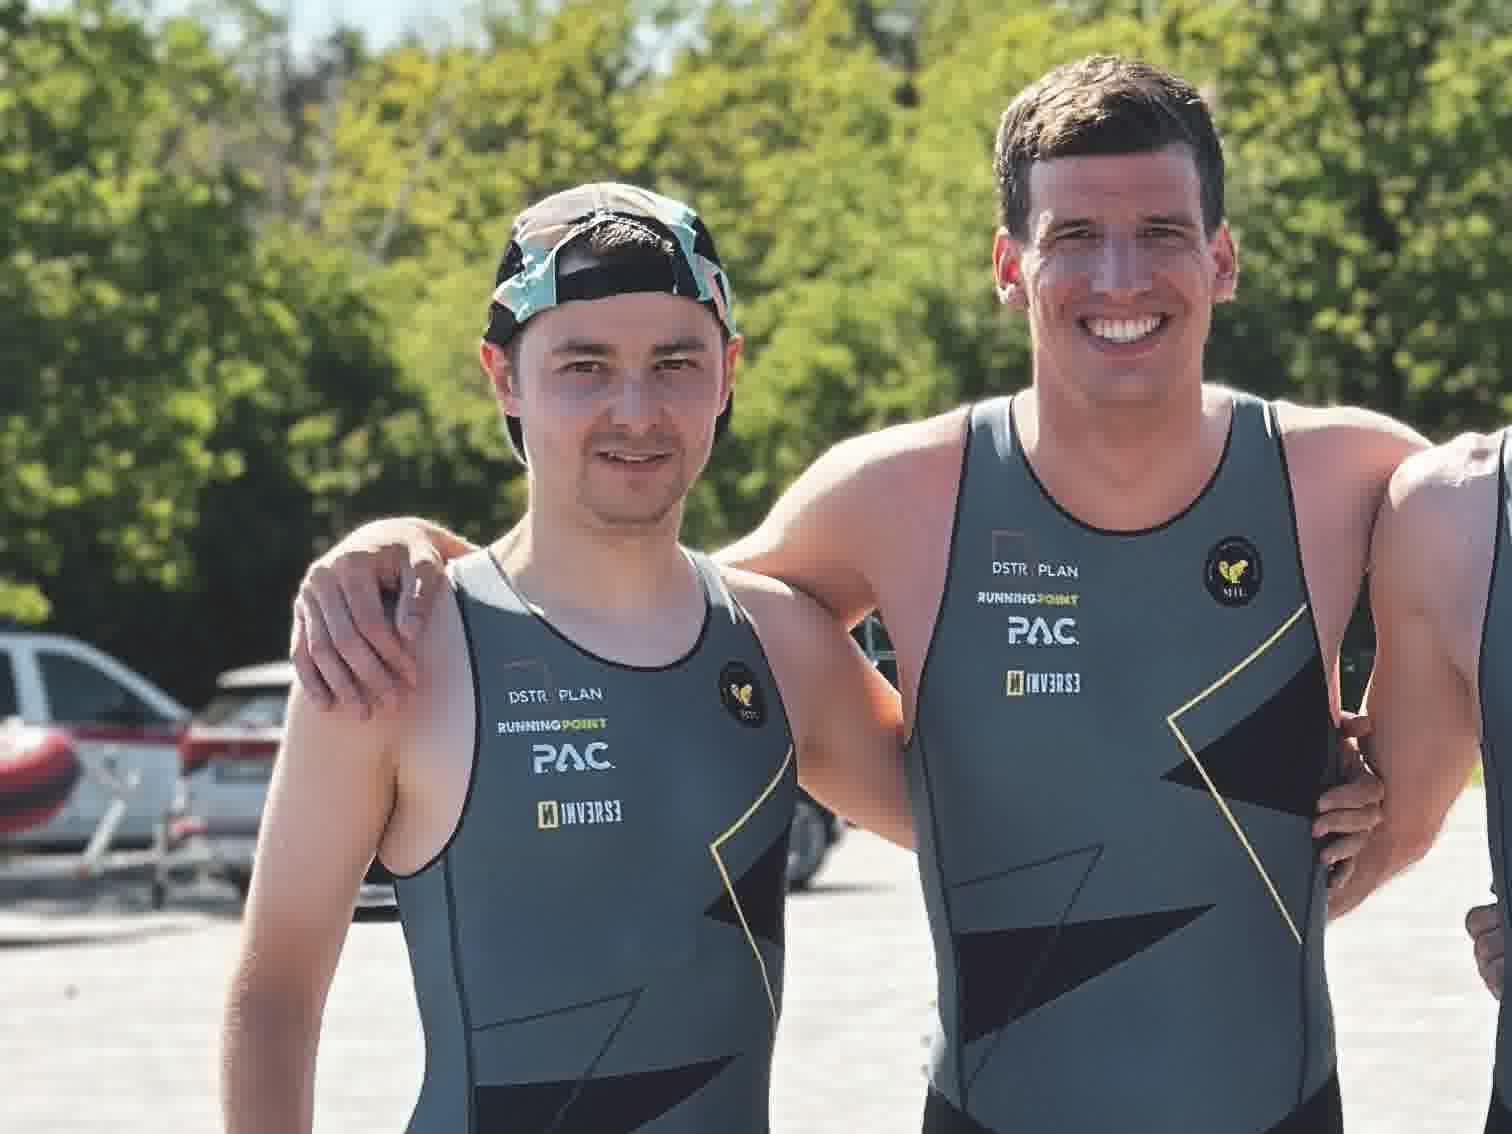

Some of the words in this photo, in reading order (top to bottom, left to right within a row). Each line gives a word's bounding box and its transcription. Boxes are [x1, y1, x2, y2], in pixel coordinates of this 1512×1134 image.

[992, 561, 1027, 576] DSTR
[1038, 563, 1079, 578] PLAN
[508, 689, 547, 704] DSTR
[558, 687, 603, 701] PLAN
[498, 718, 608, 734] RUNNINGPOINT
